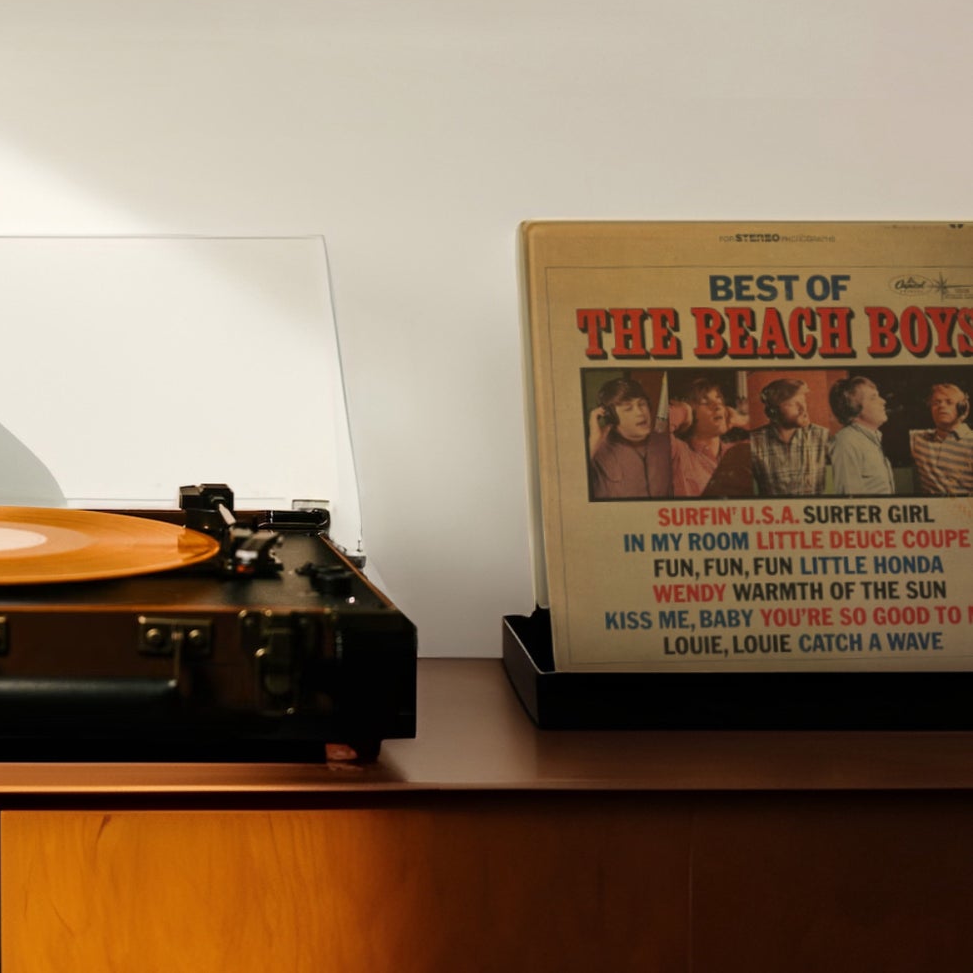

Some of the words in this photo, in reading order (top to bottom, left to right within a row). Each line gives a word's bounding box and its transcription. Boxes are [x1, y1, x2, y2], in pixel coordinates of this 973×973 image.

[735, 233, 780, 242] STEREO
[709, 274, 799, 302] BEST
[806, 274, 851, 302] OF
[576, 307, 683, 359] THE
[692, 306, 858, 359] BEACH
[658, 507, 737, 527] SURFIN'
[741, 506, 800, 526] U.S.A.
[803, 505, 882, 525] SURFER
[888, 505, 935, 524] GIRL
[624, 534, 645, 552] IN
[651, 533, 683, 551] MY
[689, 532, 749, 551] ROOM
[756, 531, 824, 550] LITTLE
[830, 530, 896, 549] DEUCE
[902, 530, 971, 548] COUPE
[654, 559, 700, 580] FUN,
[704, 558, 750, 579] FUN,
[753, 557, 793, 576] FUN
[800, 557, 868, 575] LITTLE
[873, 556, 944, 574] HONDA
[653, 584, 727, 603] WENDY
[732, 583, 824, 602] WARMTH
[830, 582, 856, 600] OF
[860, 581, 900, 600] THE
[906, 580, 947, 599] SUN
[605, 611, 653, 630] KISS
[658, 610, 696, 632] ME,
[699, 609, 754, 629] BABY
[760, 608, 834, 627] YOU'RE
[839, 607, 867, 626] SO
[872, 606, 931, 625] GOOD
[934, 605, 962, 625] TO
[663, 636, 729, 657] LOUIE,
[732, 635, 793, 654] LOUIE
[798, 633, 864, 652] CATCH
[868, 633, 883, 651] A
[887, 632, 944, 651] WAVE
